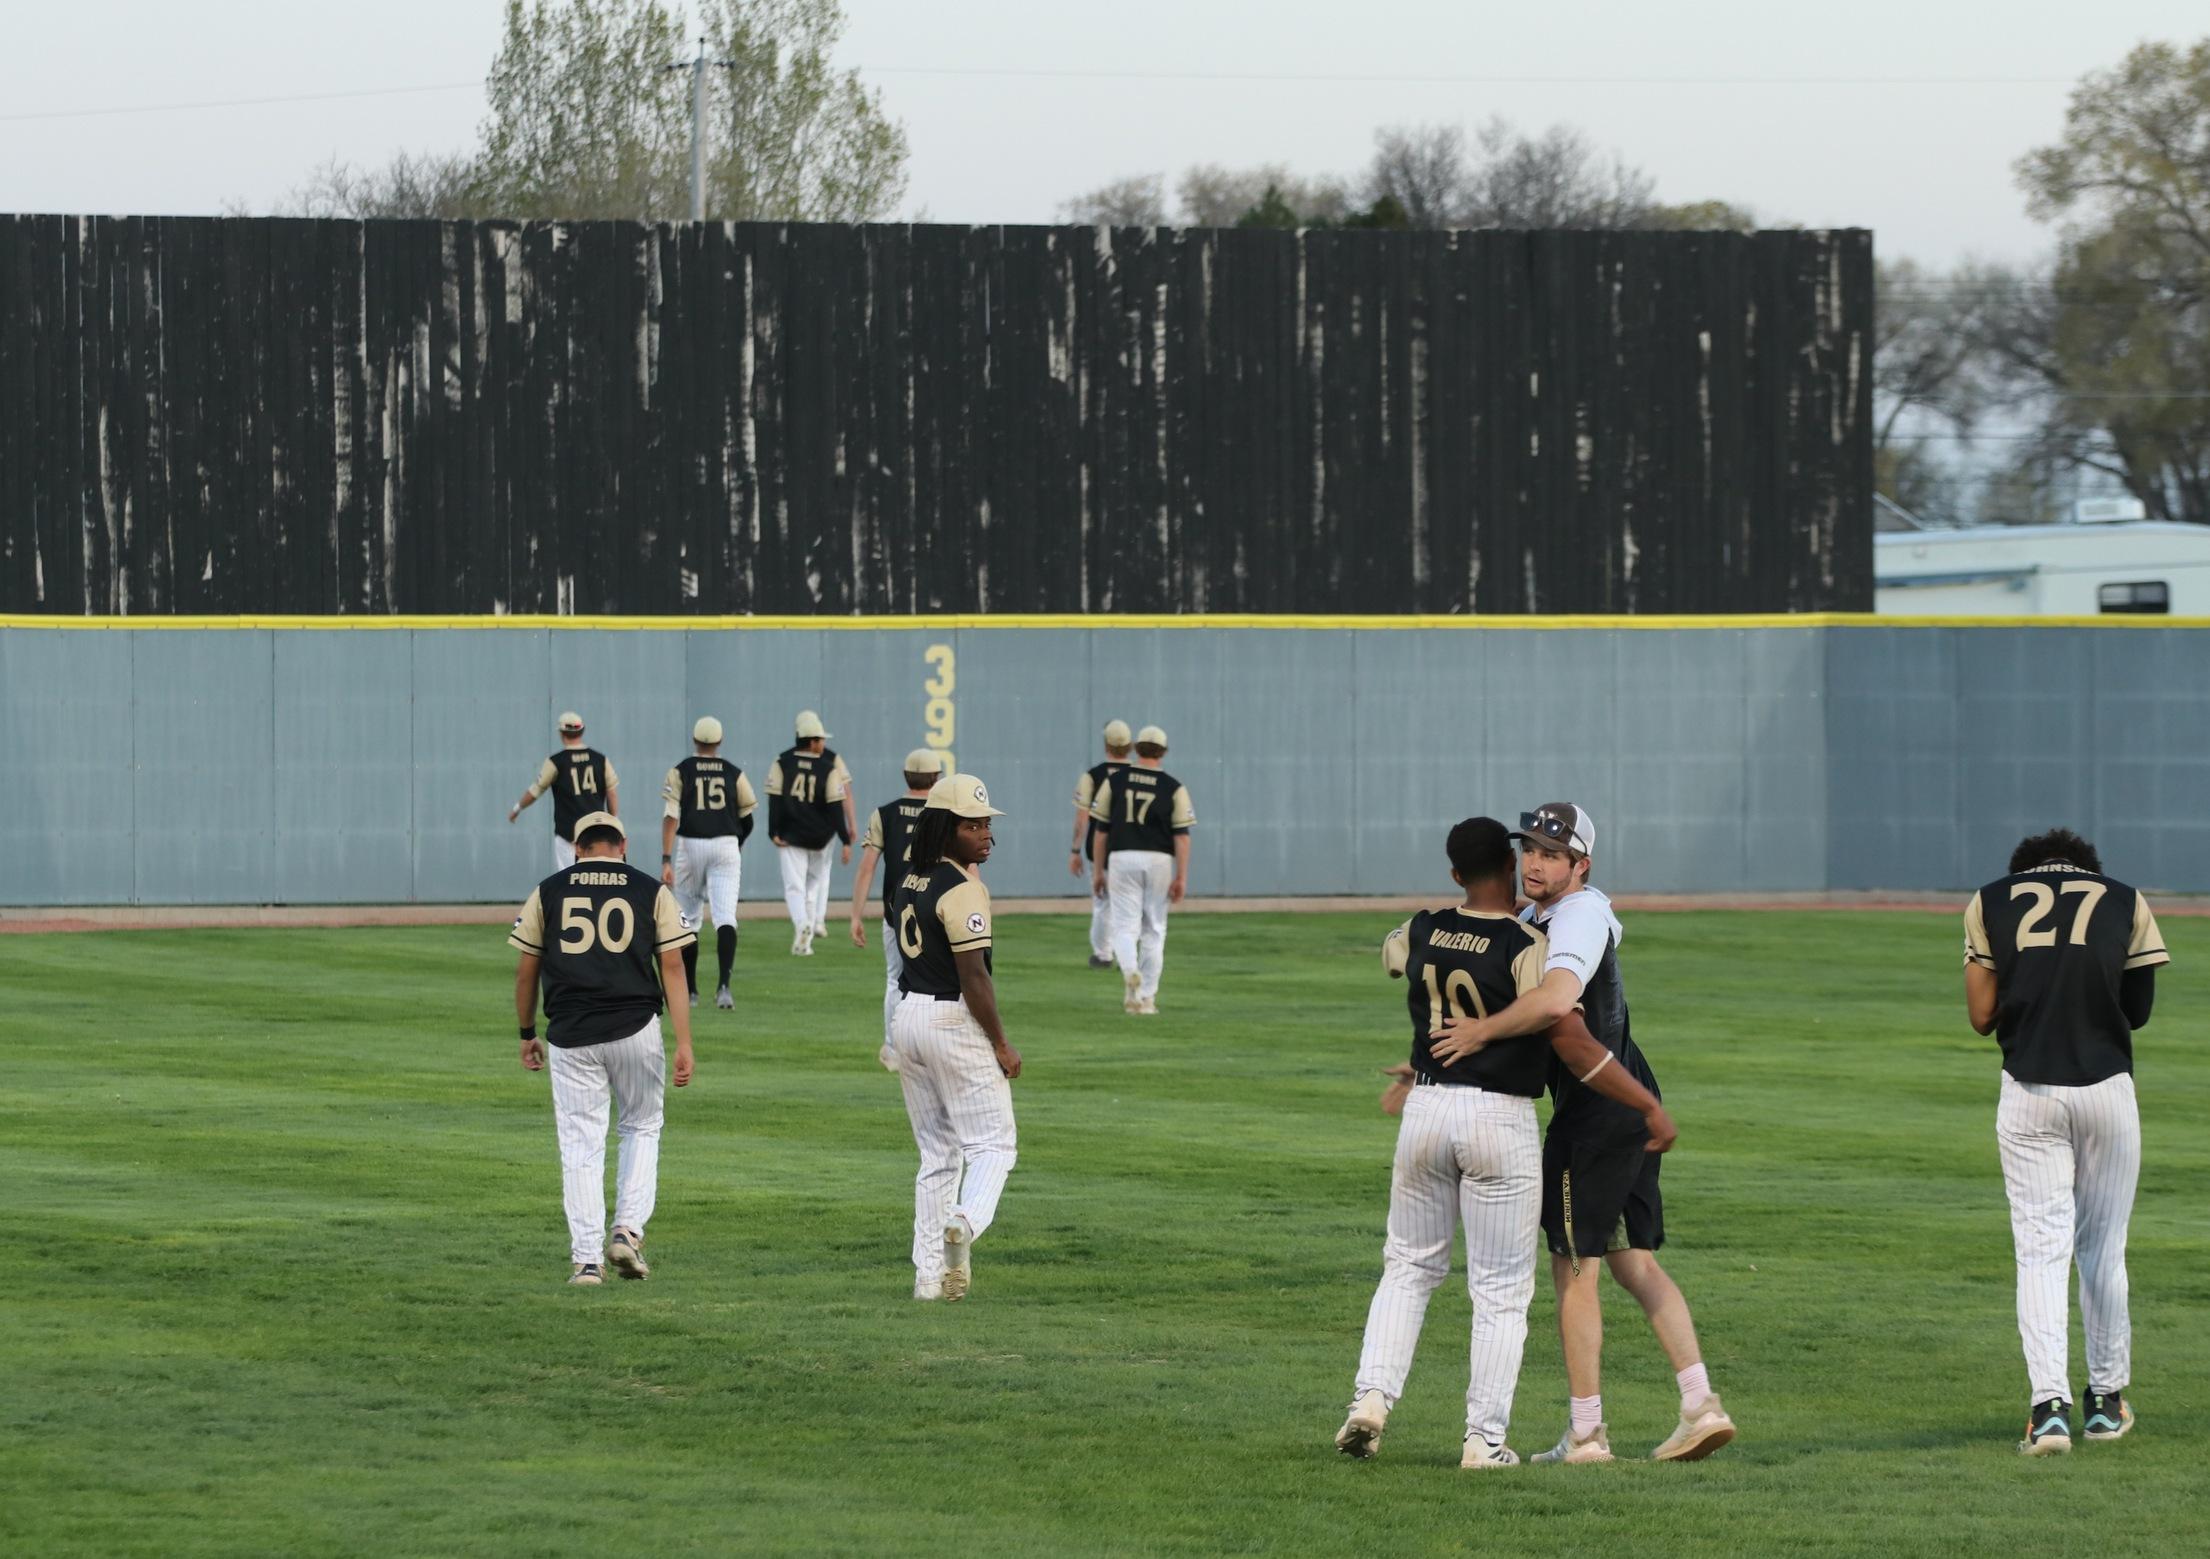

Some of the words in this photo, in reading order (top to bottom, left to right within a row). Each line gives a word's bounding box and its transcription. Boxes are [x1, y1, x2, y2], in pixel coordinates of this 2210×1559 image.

[570, 765, 598, 796] 14
[695, 776, 726, 811] 15
[790, 773, 817, 803] 41
[1125, 788, 1157, 825] 17
[569, 872, 628, 886] PORRAS
[559, 896, 635, 954] 50
[2009, 879, 2108, 952] 27
[1428, 928, 1491, 954] VALERIO
[1422, 963, 1488, 1035] 10
